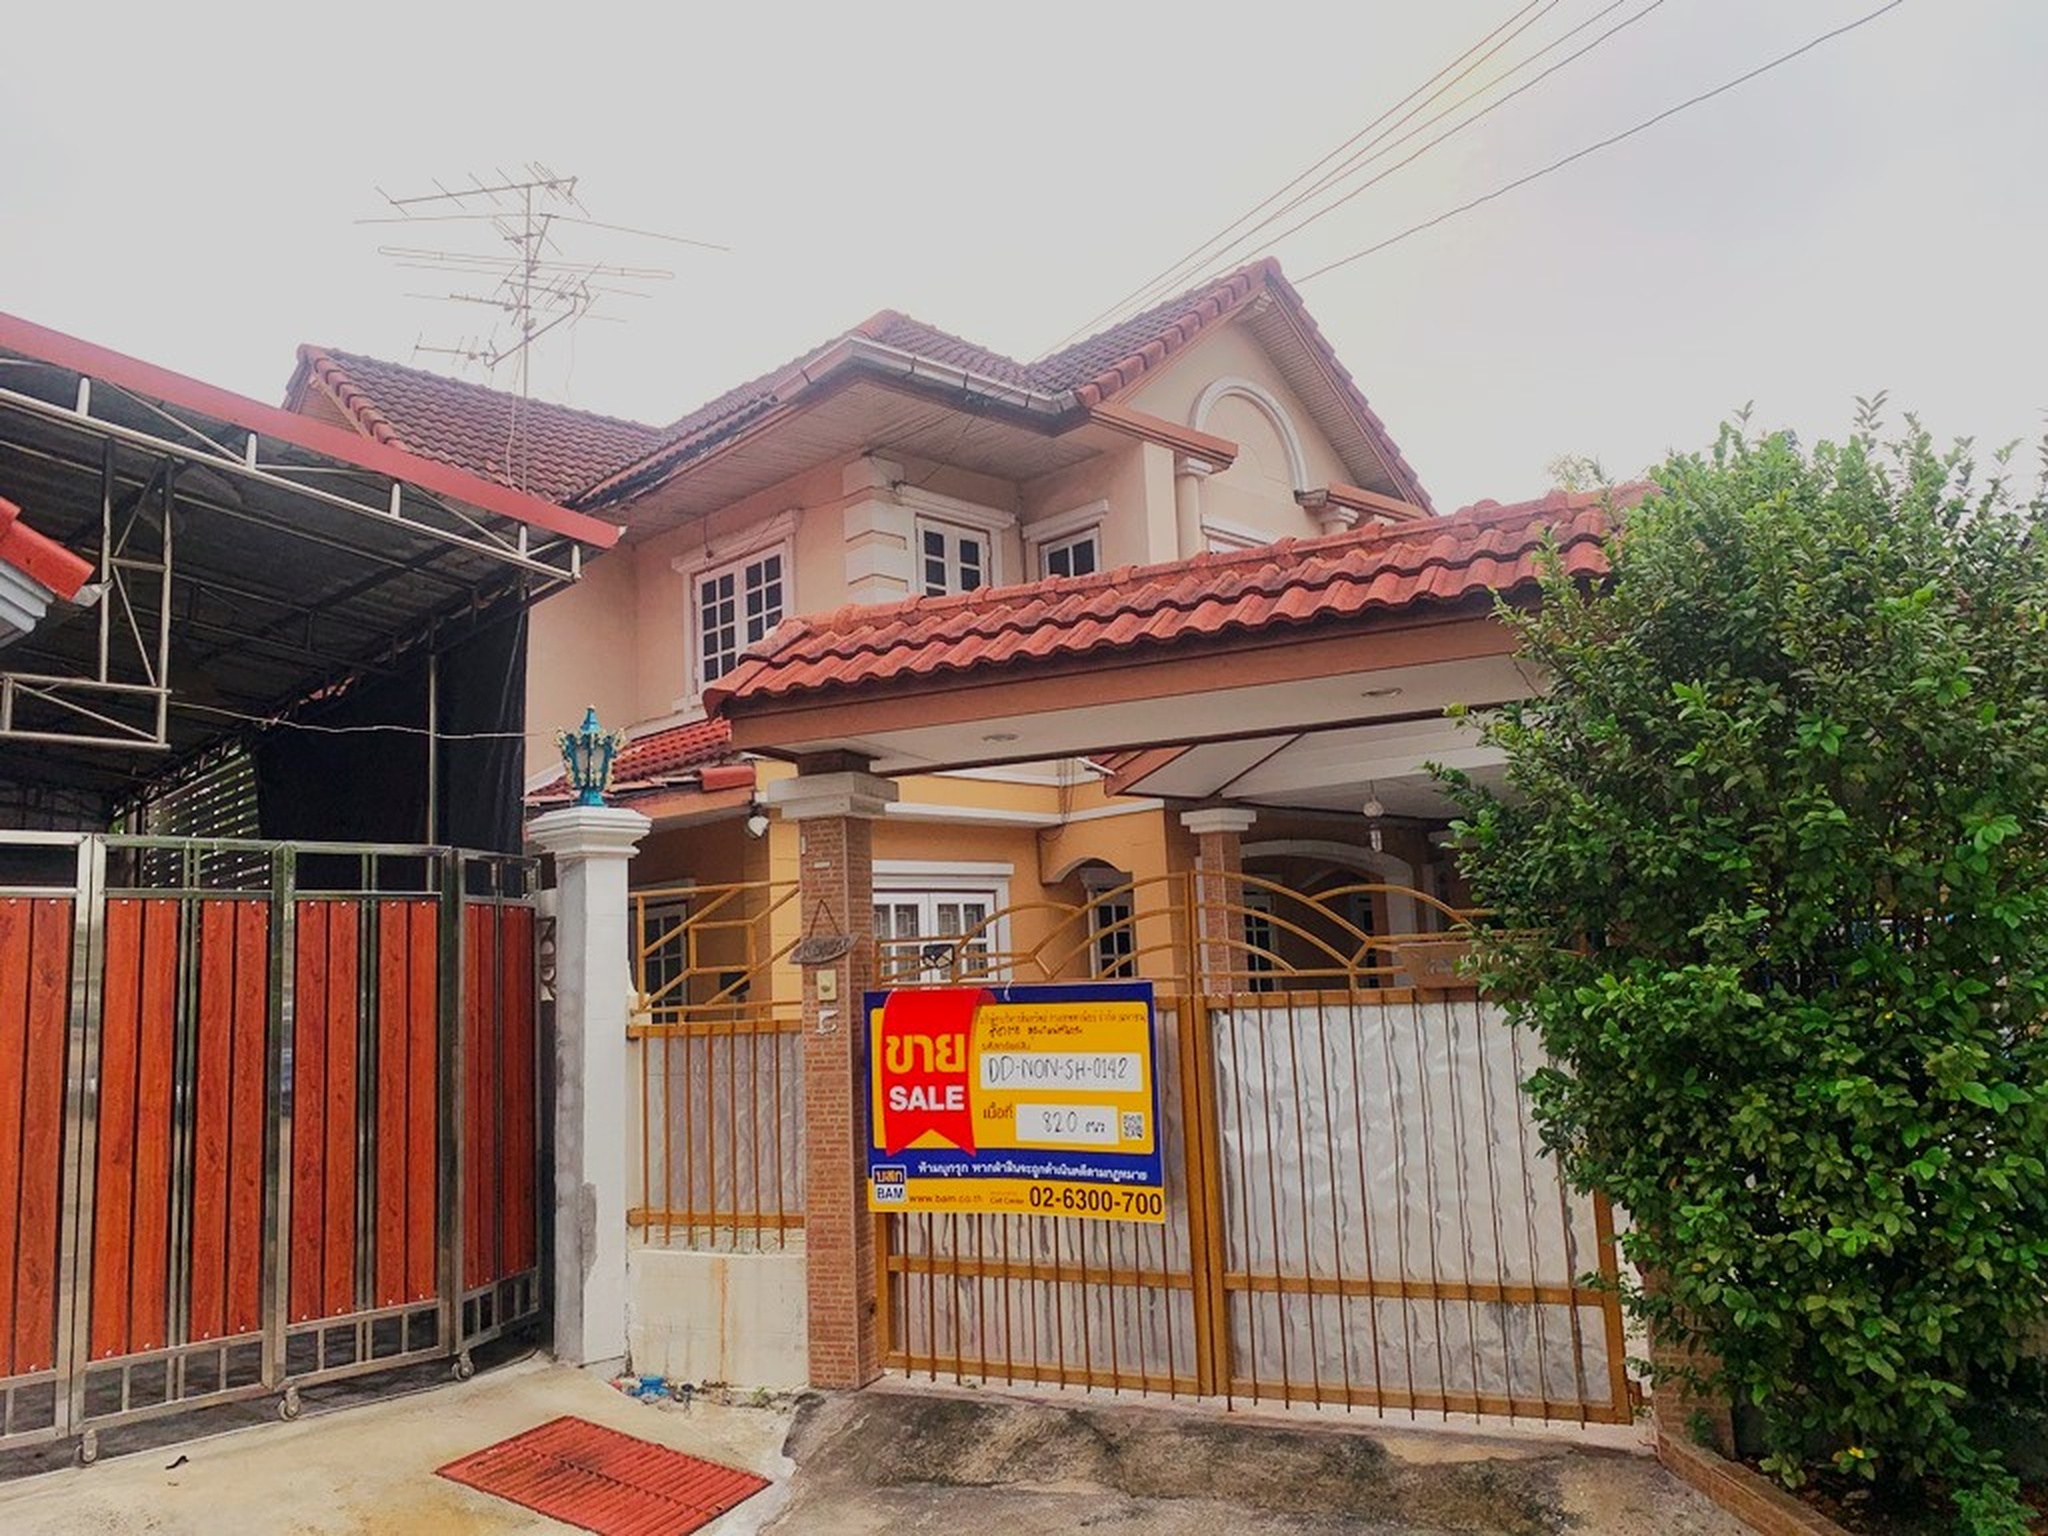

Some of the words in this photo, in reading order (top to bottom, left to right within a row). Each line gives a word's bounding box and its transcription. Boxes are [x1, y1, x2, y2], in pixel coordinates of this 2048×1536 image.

[885, 1033, 965, 1073] ขาย
[988, 1055, 1128, 1083] DD-NON-SH-0142
[889, 1086, 965, 1111] SALE
[877, 1187, 903, 1199] BAM
[1029, 1186, 1162, 1215] 02-6300-700
